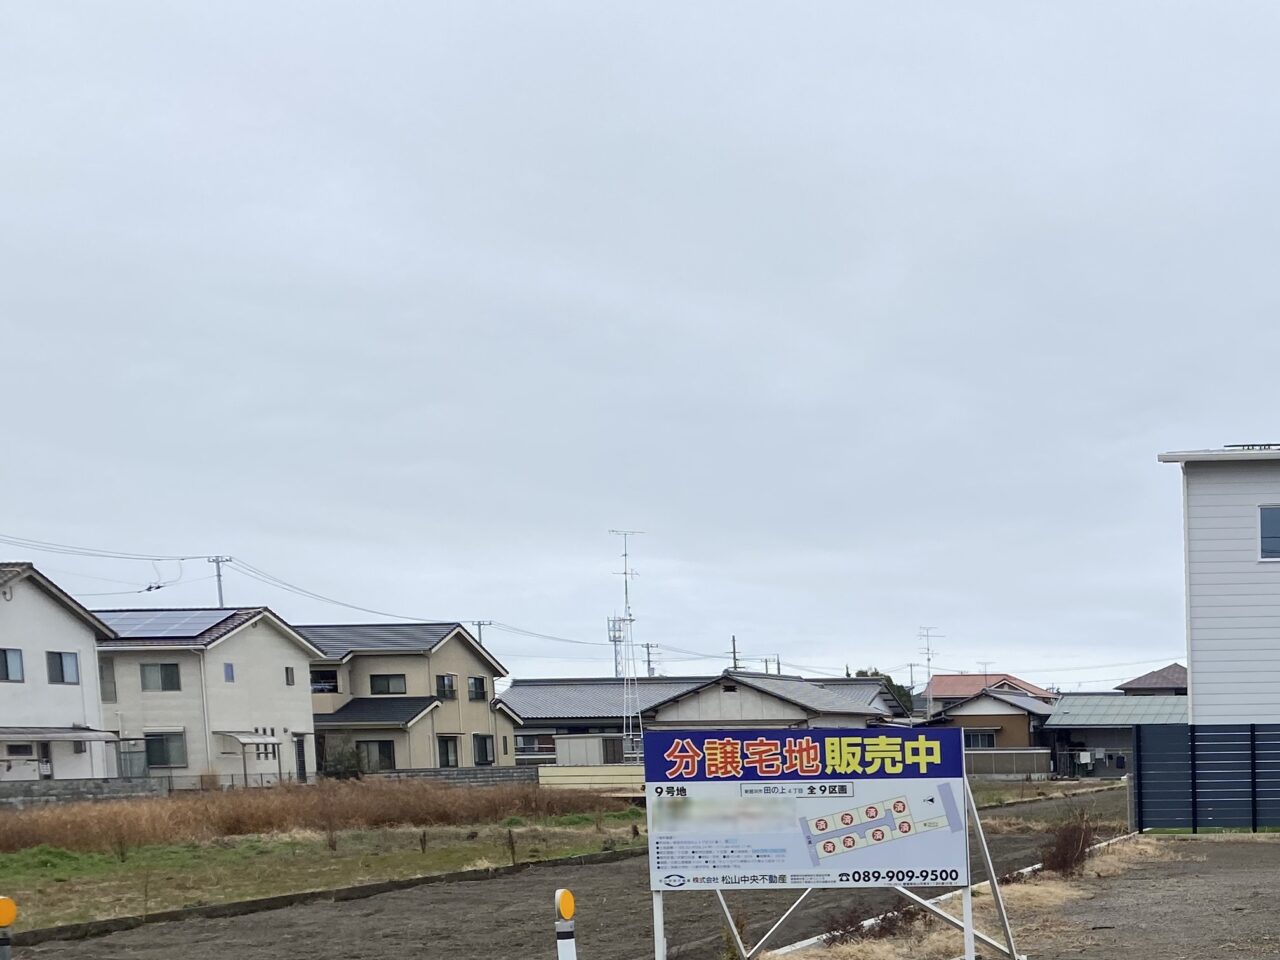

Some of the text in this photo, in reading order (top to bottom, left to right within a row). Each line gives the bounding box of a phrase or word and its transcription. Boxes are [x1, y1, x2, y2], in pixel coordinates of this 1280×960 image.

[664, 734, 942, 779] 分譲宅地販売中
[654, 786, 687, 797] 9号地
[721, 875, 787, 884] 松山中央不動産
[851, 869, 959, 883] 089-909-9500
